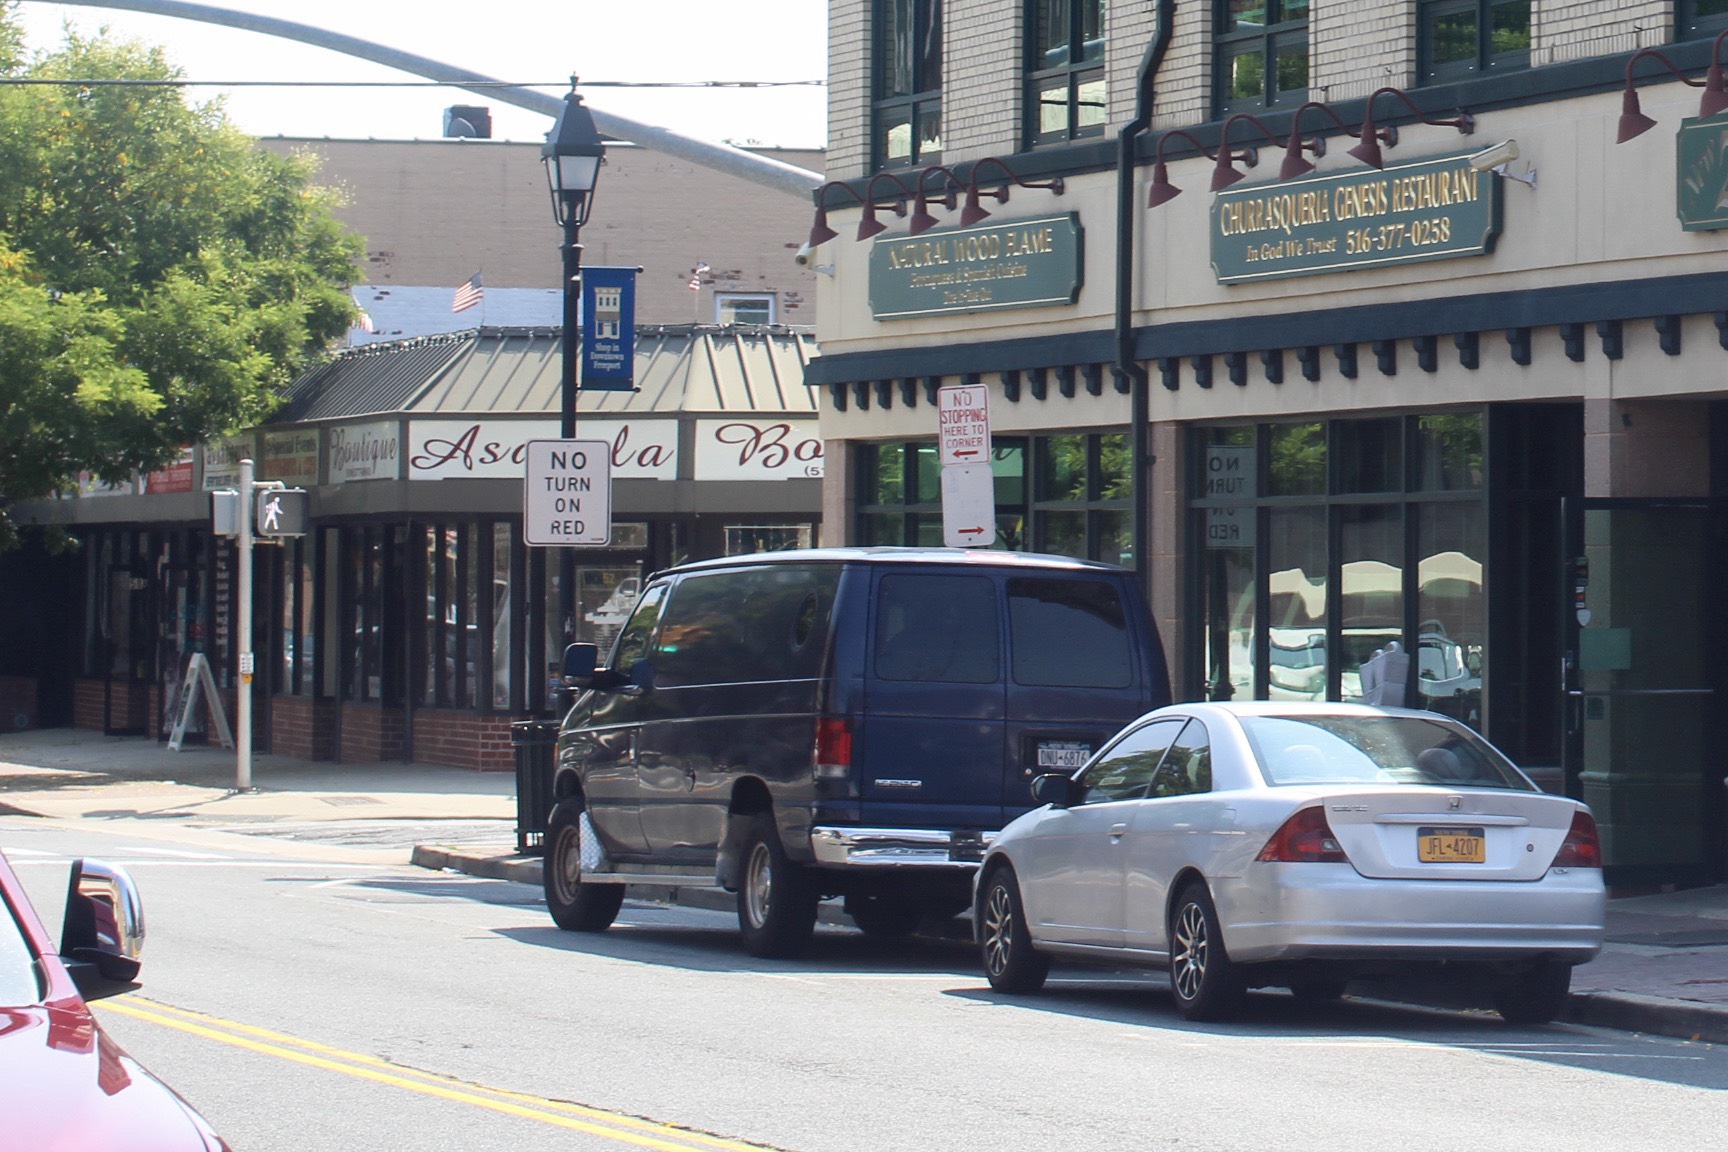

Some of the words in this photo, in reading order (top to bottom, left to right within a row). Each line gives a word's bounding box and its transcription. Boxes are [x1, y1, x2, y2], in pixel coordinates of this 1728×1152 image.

[1220, 189, 1330, 237] CHURRASQUERIA
[1334, 181, 1388, 221] GENESIS
[1392, 167, 1480, 213] RESTAURANT
[1245, 245, 1259, 262] In
[1260, 240, 1283, 260] God
[1286, 239, 1303, 258] We
[1306, 237, 1337, 256] Trust
[1345, 216, 1450, 254] 516-377-0258
[888, 239, 949, 270] NATURAL
[953, 234, 1000, 263] WOOD
[1005, 227, 1053, 258] FLAME
[595, 342, 612, 353] Shop
[612, 343, 619, 352] in
[590, 352, 624, 360] Downtown
[593, 361, 620, 371] Freeport
[953, 392, 972, 407] NO
[941, 408, 986, 424] STOPPING
[944, 426, 967, 436] HERE
[972, 424, 984, 435] TO
[946, 437, 983, 448] CORNER
[331, 428, 397, 474] Boutique
[551, 451, 587, 470] NO
[544, 477, 591, 491] TURN
[555, 498, 580, 513] ON
[551, 520, 585, 535] RED
